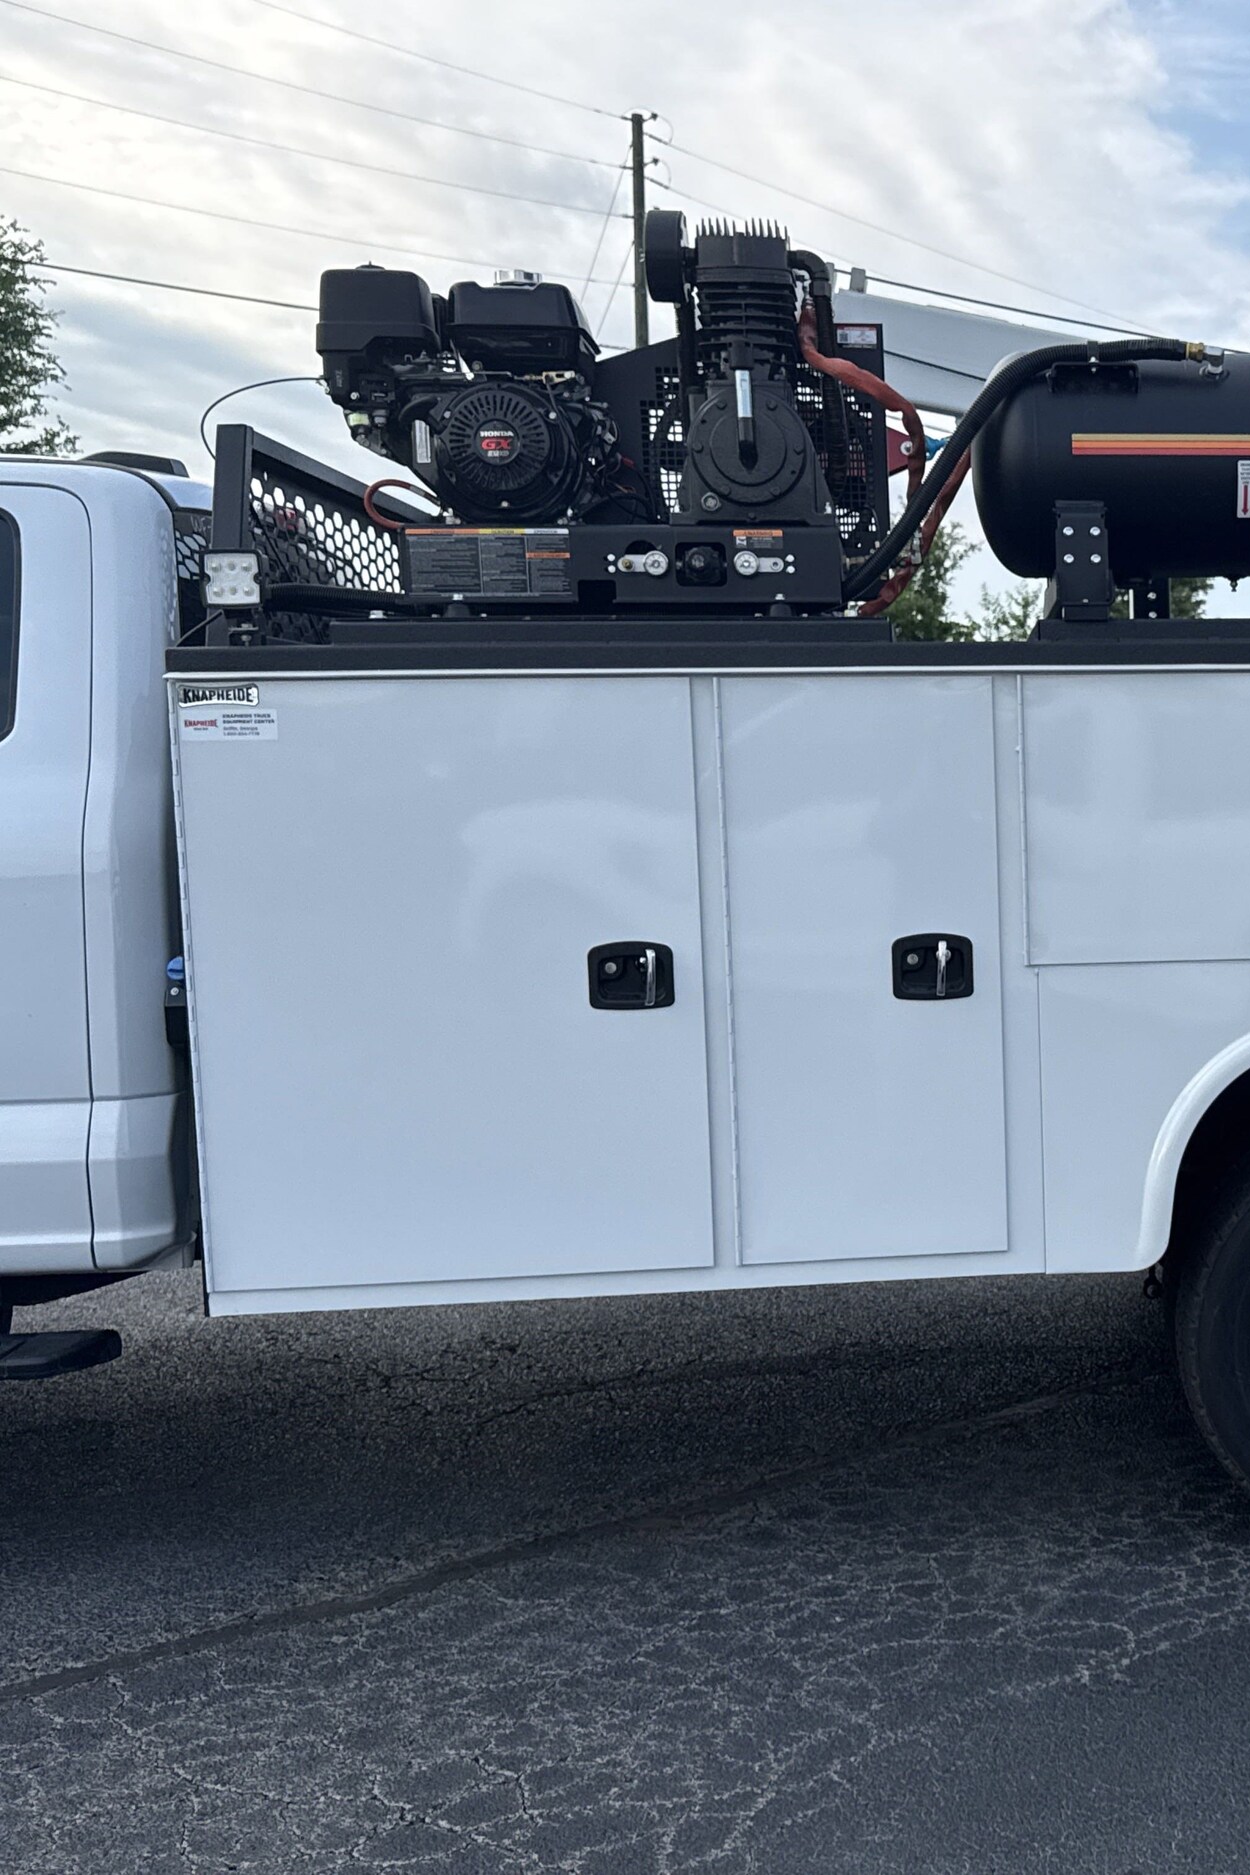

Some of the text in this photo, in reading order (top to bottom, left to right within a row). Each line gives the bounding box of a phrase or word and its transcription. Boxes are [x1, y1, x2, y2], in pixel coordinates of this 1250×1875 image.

[481, 438, 512, 450] GX
[183, 687, 254, 704] KNAPHEIDE
[184, 719, 218, 728] KNAPHEIDE
